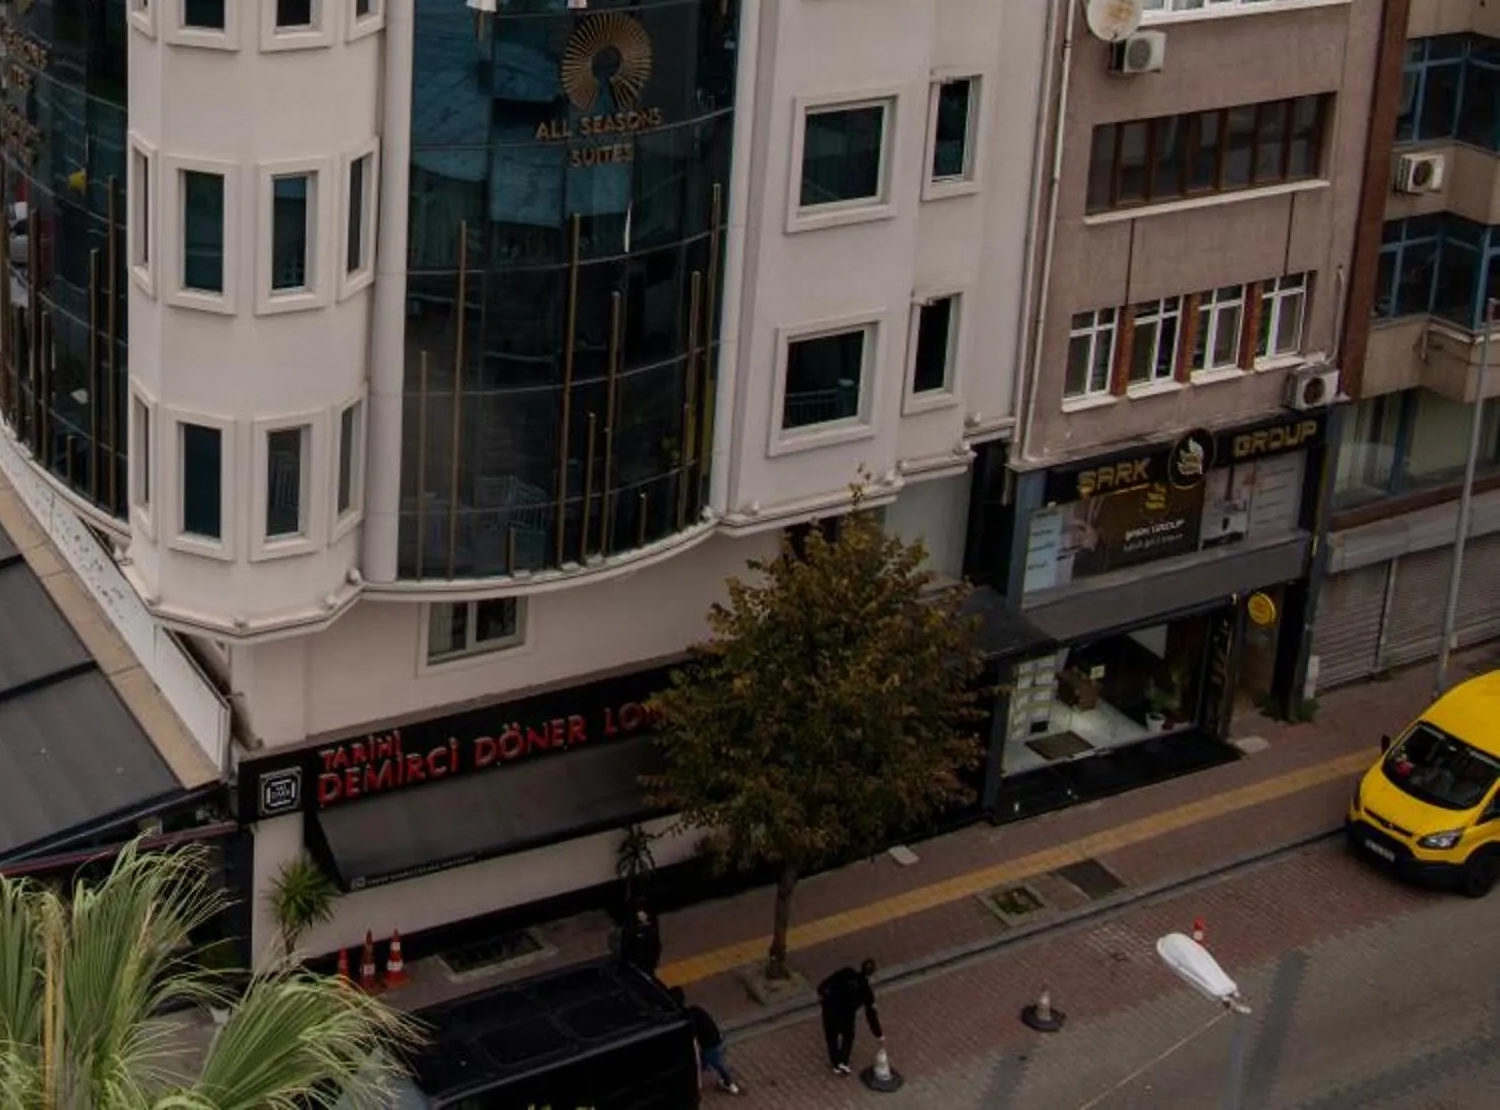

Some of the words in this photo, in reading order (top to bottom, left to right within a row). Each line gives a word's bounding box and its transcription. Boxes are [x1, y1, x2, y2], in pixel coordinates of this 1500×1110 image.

[535, 121, 571, 140] ALL
[581, 107, 663, 135] SEASONS
[568, 144, 635, 168] SUITES
[1232, 420, 1318, 459] GROUP
[316, 738, 460, 807] DEMİRCİ
[472, 714, 588, 768] DÖNER
[318, 729, 402, 772] TARİHİ
